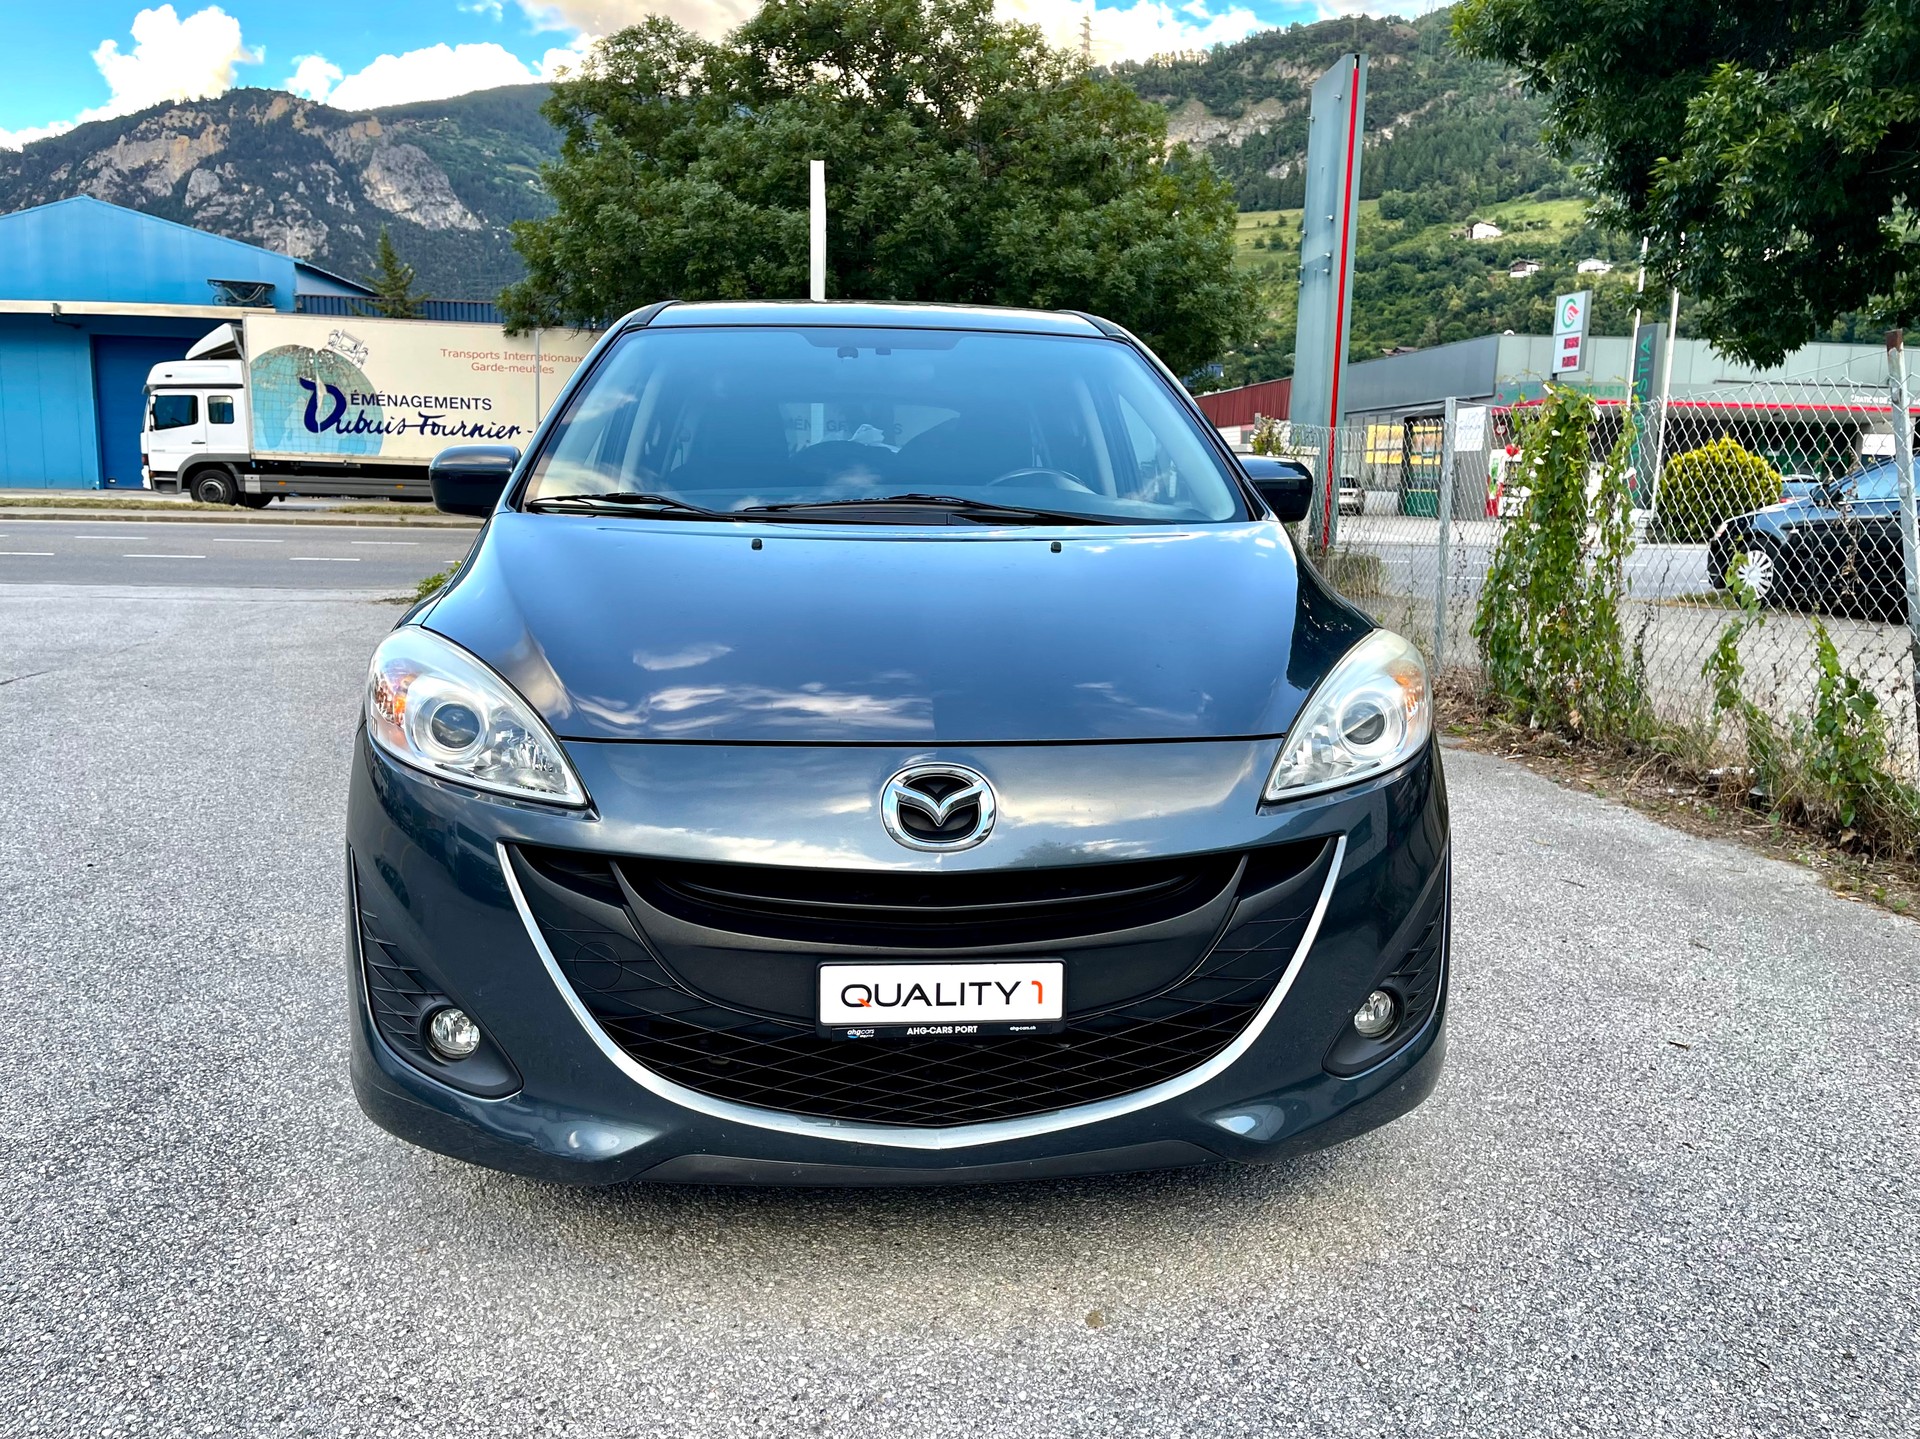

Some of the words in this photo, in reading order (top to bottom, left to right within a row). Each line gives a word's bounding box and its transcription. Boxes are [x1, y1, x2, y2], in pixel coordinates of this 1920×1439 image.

[440, 348, 500, 360] Transports
[504, 351, 584, 364] Internationaux
[841, 980, 1022, 1008] QUALITY
[1031, 980, 1044, 1005] 1
[906, 1026, 953, 1036] AHG-CARS
[955, 1025, 979, 1034] PORT
